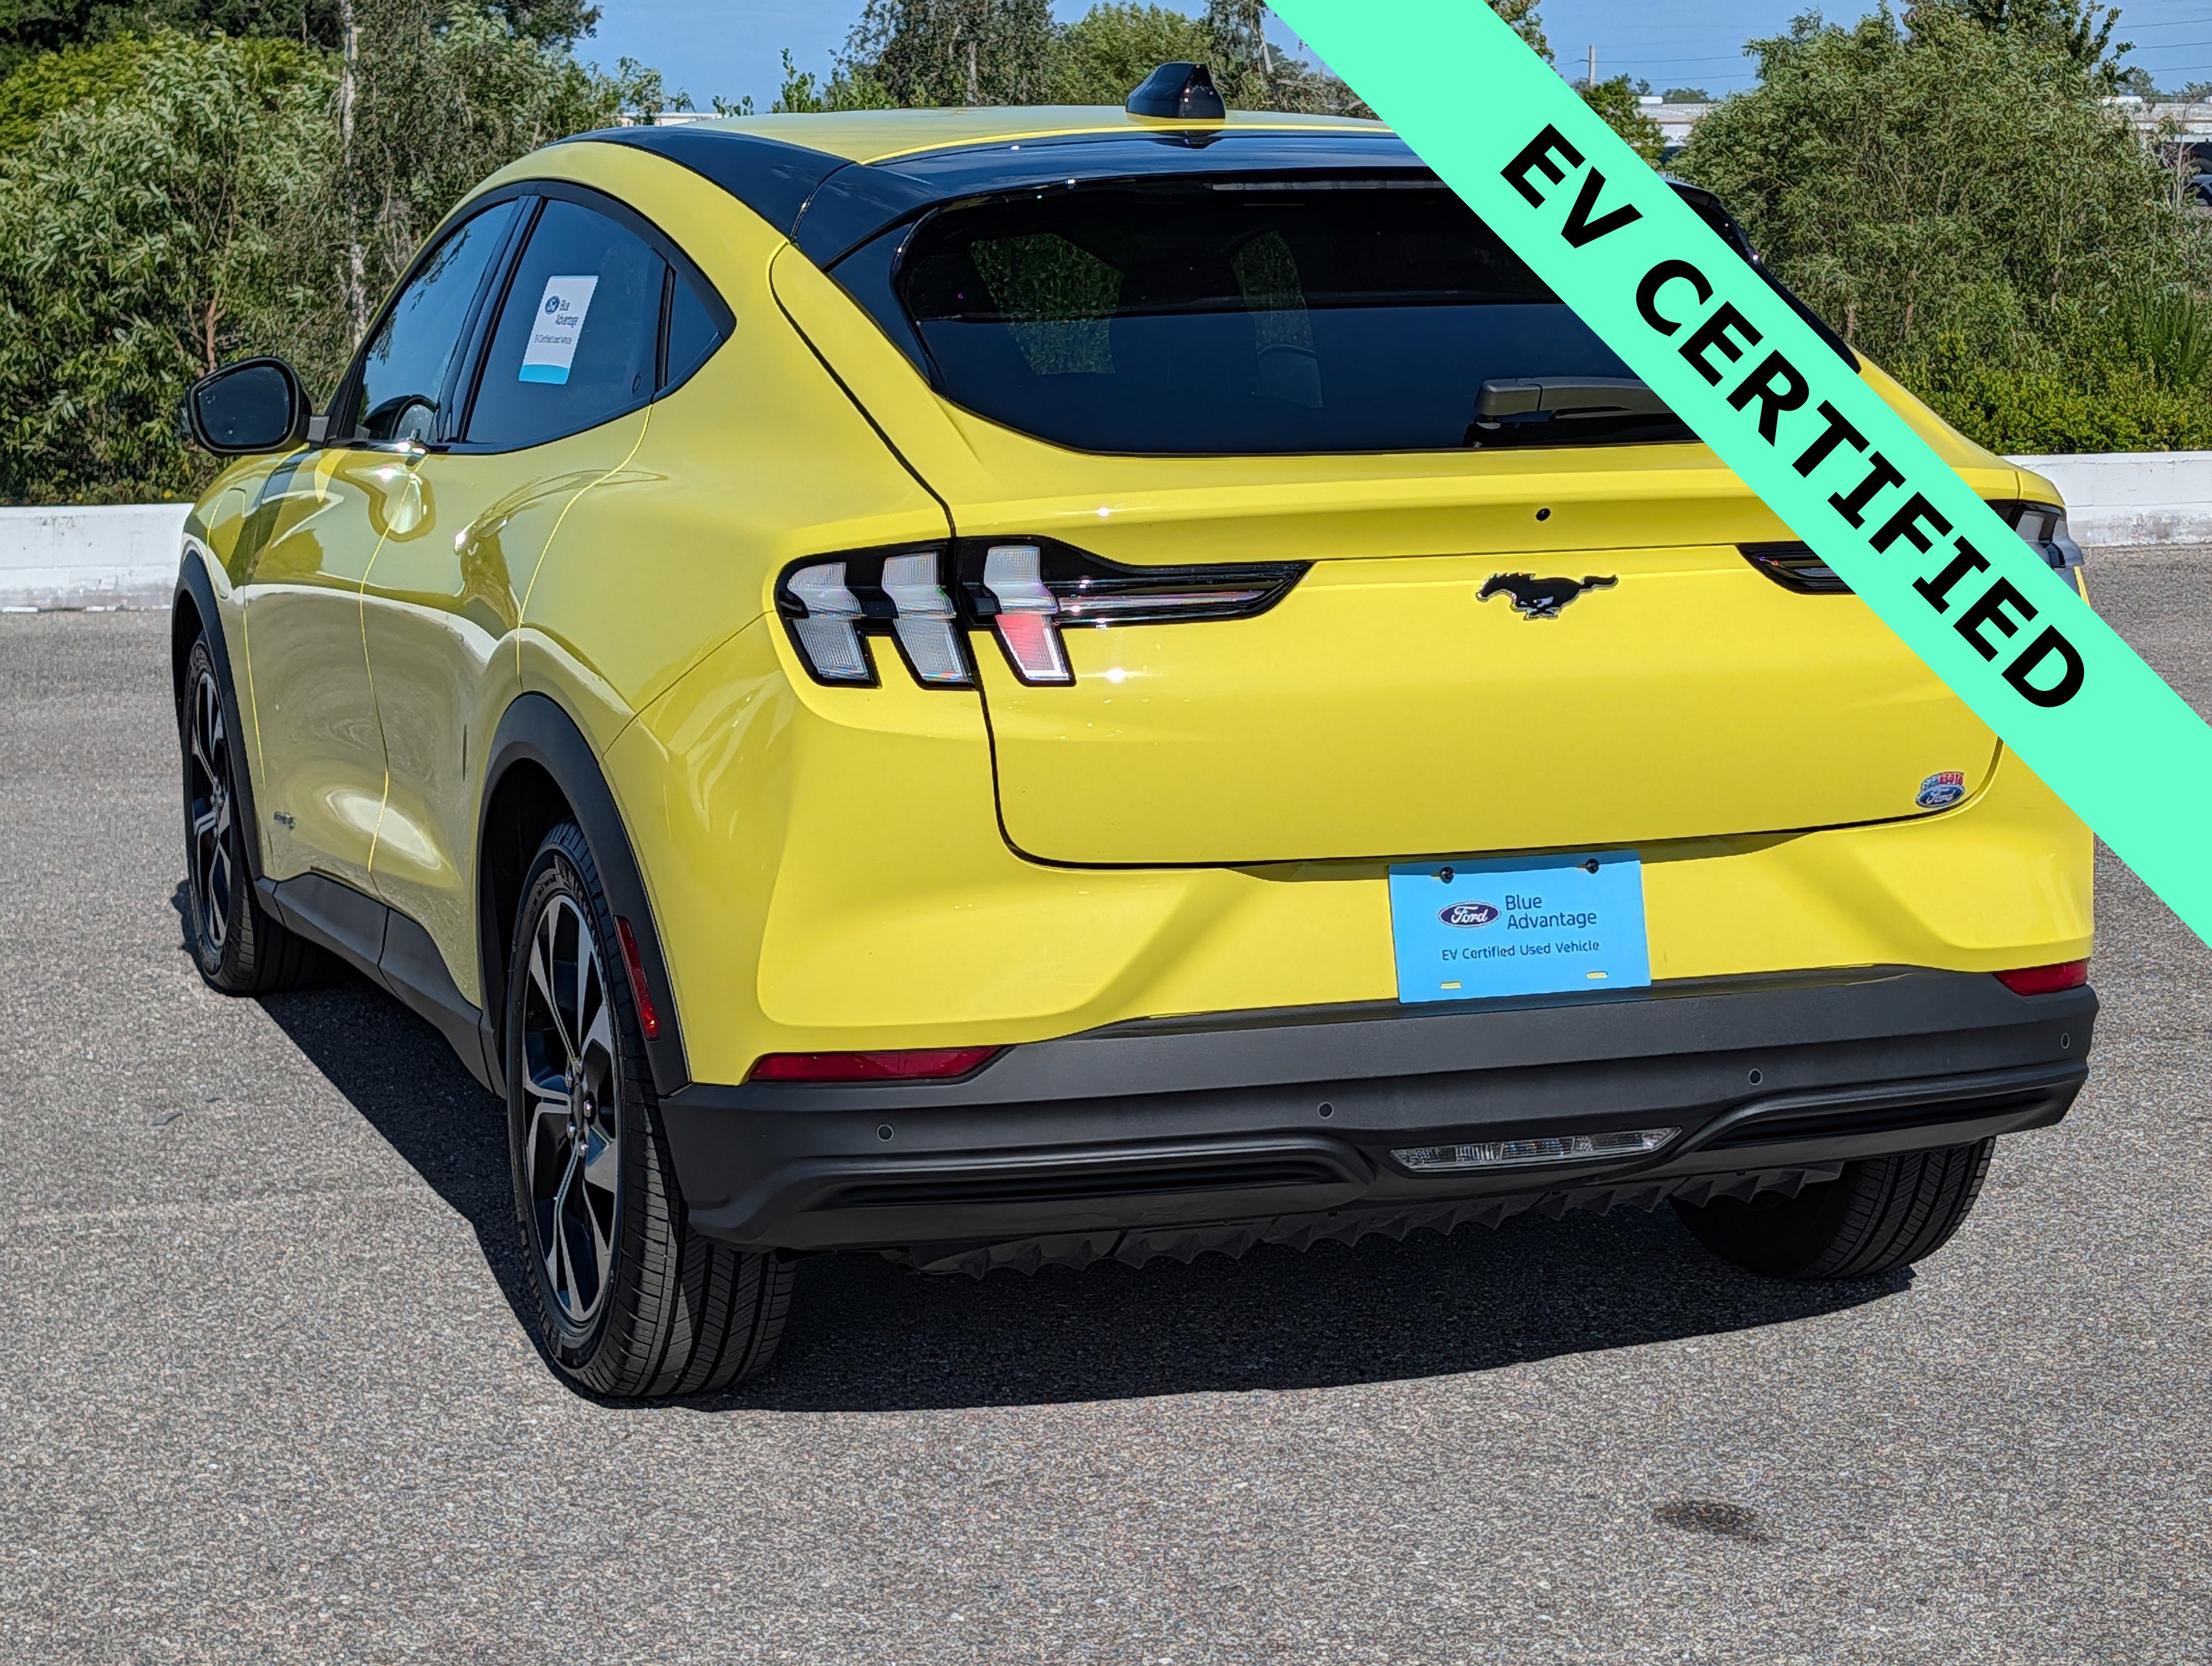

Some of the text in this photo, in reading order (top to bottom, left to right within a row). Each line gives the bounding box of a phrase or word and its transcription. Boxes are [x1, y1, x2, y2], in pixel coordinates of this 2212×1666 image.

[1505, 894, 1542, 911] Blue
[1507, 912, 1597, 930] Advantage
[1442, 940, 1599, 960] EV Certified Used Vehicle
